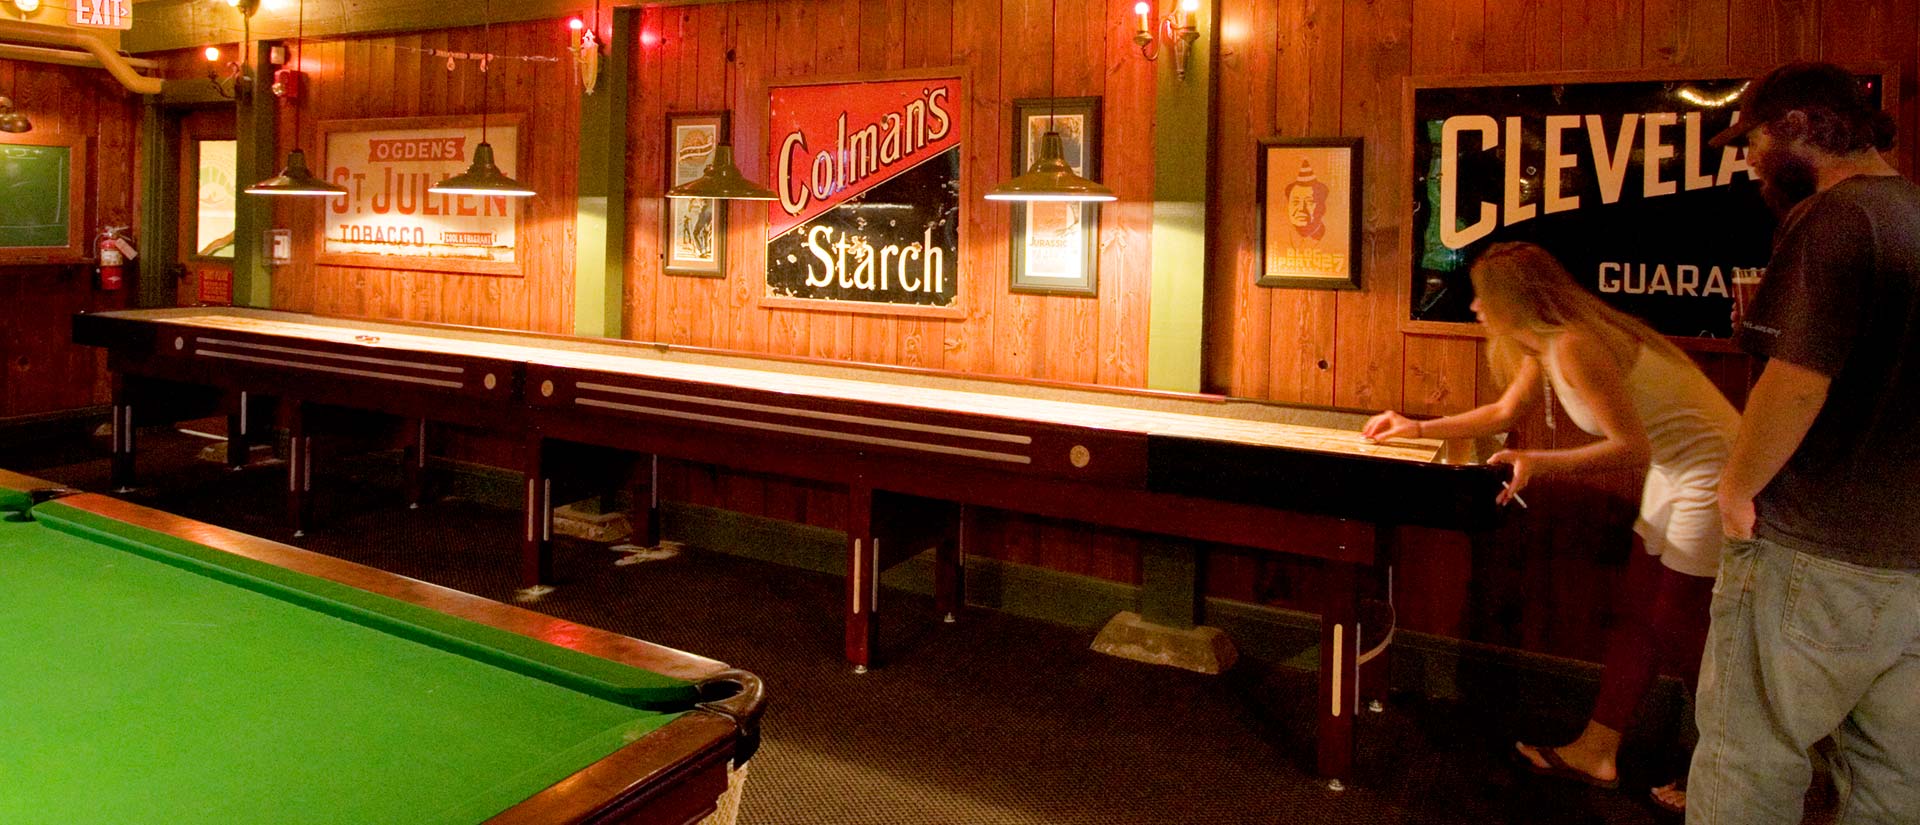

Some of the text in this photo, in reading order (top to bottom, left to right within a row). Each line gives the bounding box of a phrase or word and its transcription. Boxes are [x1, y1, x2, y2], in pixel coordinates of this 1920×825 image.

[76, 0, 122, 26] EXIT
[376, 139, 457, 159] OGDEN'S
[778, 84, 950, 215] Colman's
[339, 224, 425, 248] TOBACCO
[805, 224, 944, 293] Starch
